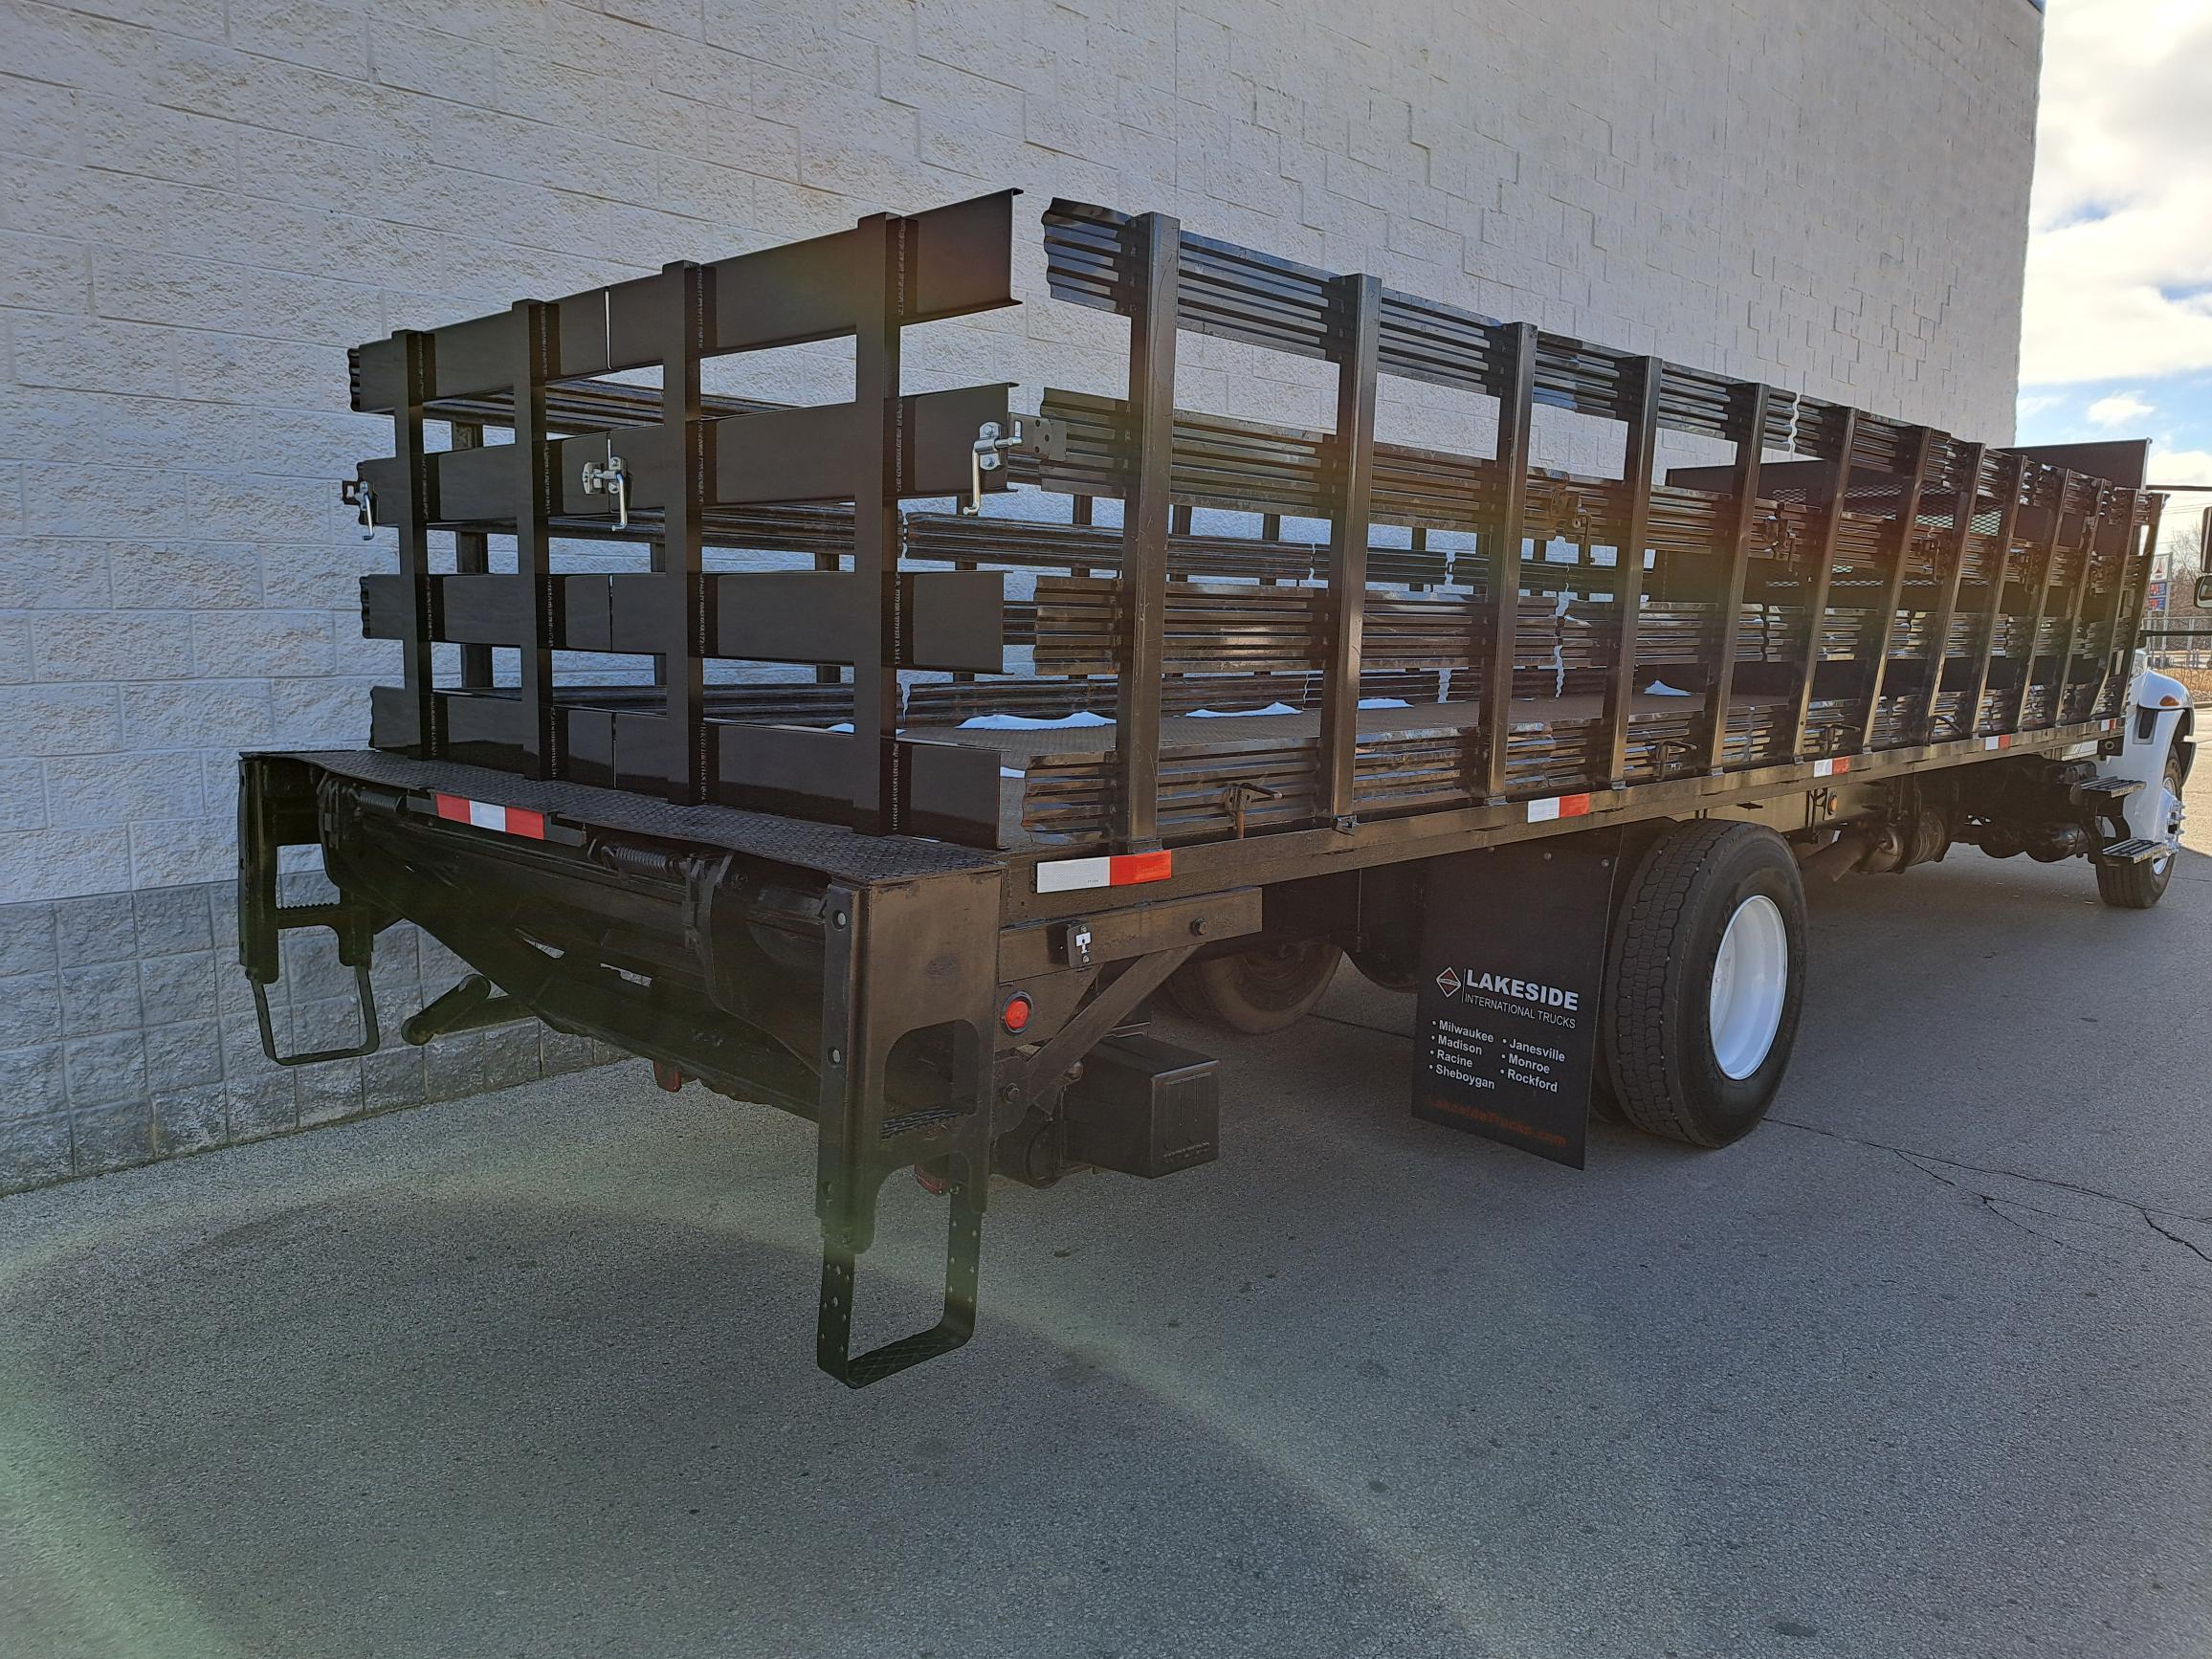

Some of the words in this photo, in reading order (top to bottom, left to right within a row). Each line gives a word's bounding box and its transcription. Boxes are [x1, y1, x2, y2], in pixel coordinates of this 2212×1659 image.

[1467, 969, 1579, 1011] LAKESIDE
[1465, 993, 1535, 1019] INTERNATIONAL
[1537, 1010, 1576, 1029] TRUCKS
[1439, 1020, 1494, 1042] Milwaukee
[1438, 1035, 1482, 1055] Madison
[1510, 1039, 1565, 1062] Janesville
[1437, 1050, 1472, 1068] Racine
[1509, 1053, 1550, 1073] Monroe
[1436, 1065, 1494, 1090] Sheboygan
[1507, 1069, 1558, 1093] Rockford
